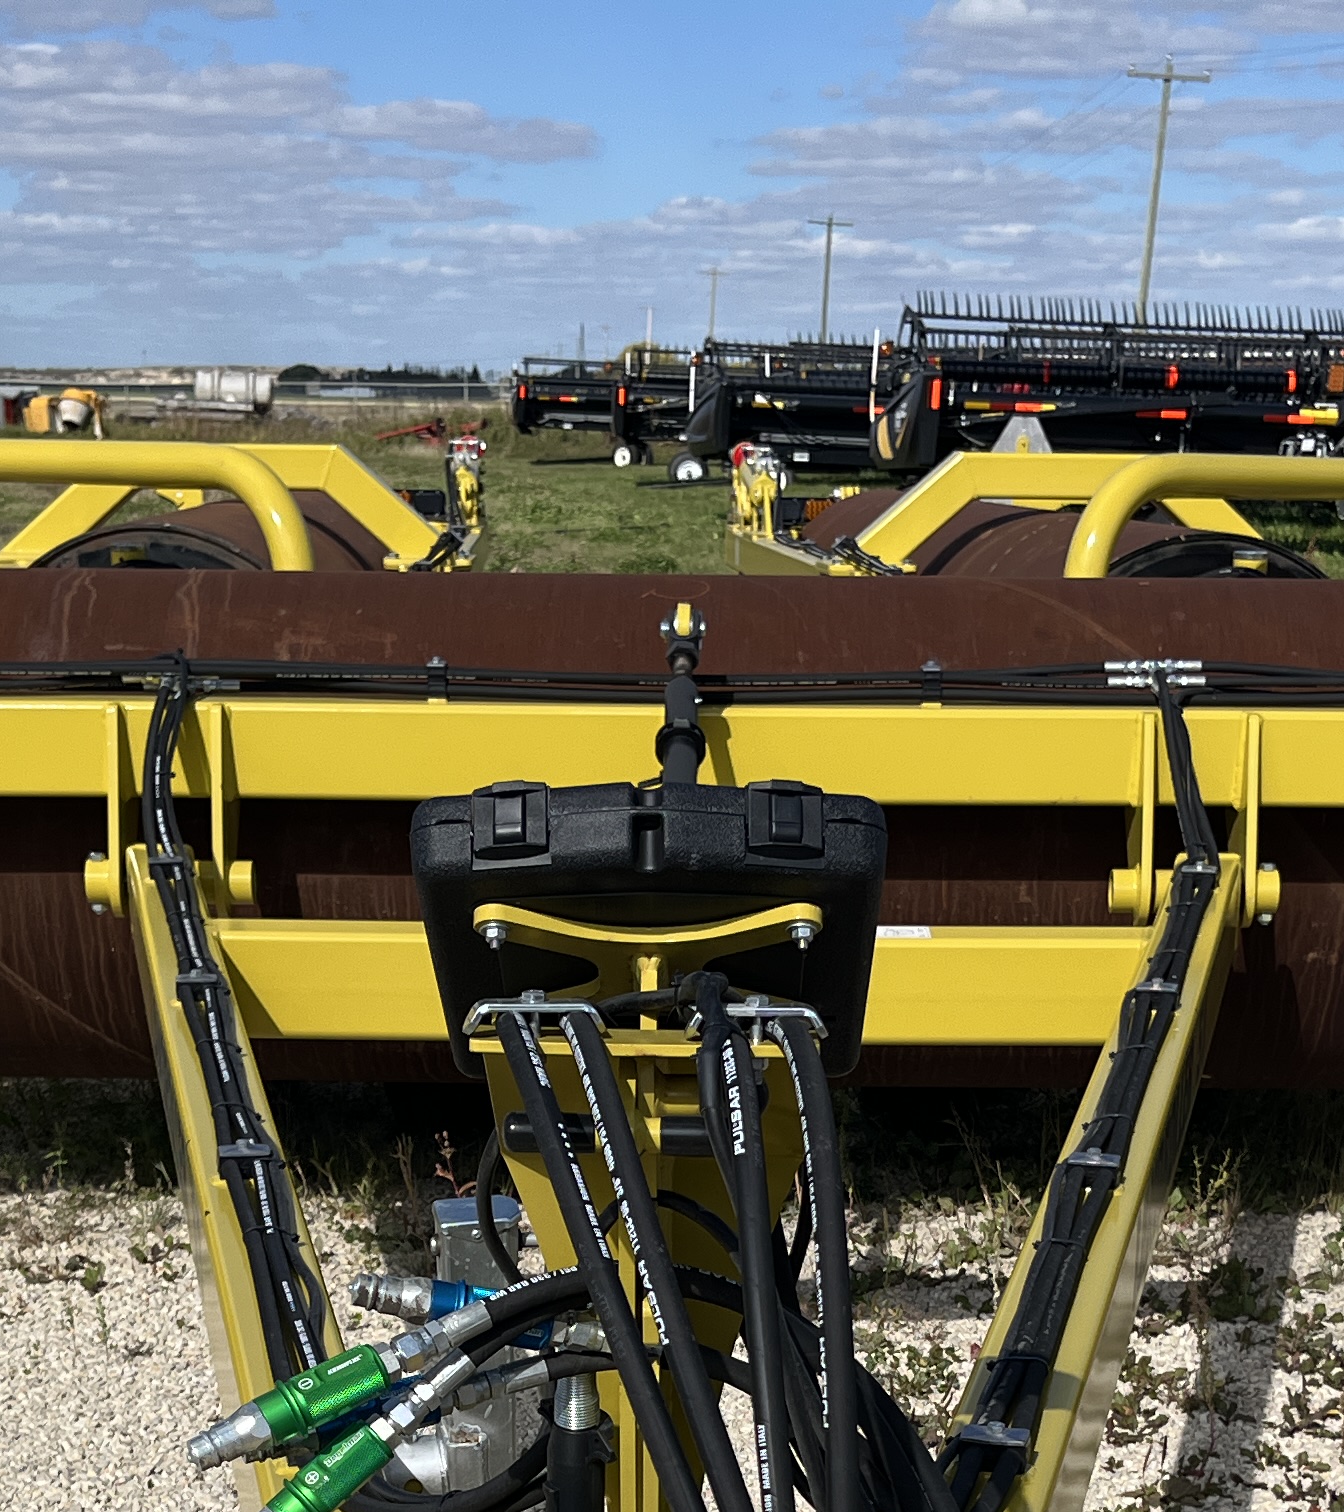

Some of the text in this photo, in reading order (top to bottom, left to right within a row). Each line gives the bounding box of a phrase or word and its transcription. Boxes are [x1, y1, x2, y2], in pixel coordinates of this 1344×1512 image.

[728, 1086, 746, 1156] PULSAR
[489, 1290, 508, 1301] WP
[508, 1280, 530, 1293] BAR
[637, 1259, 670, 1346] PULSAR
[757, 1424, 767, 1447] ITALY
[759, 1448, 769, 1460] IN
[761, 1462, 771, 1490] MADE
